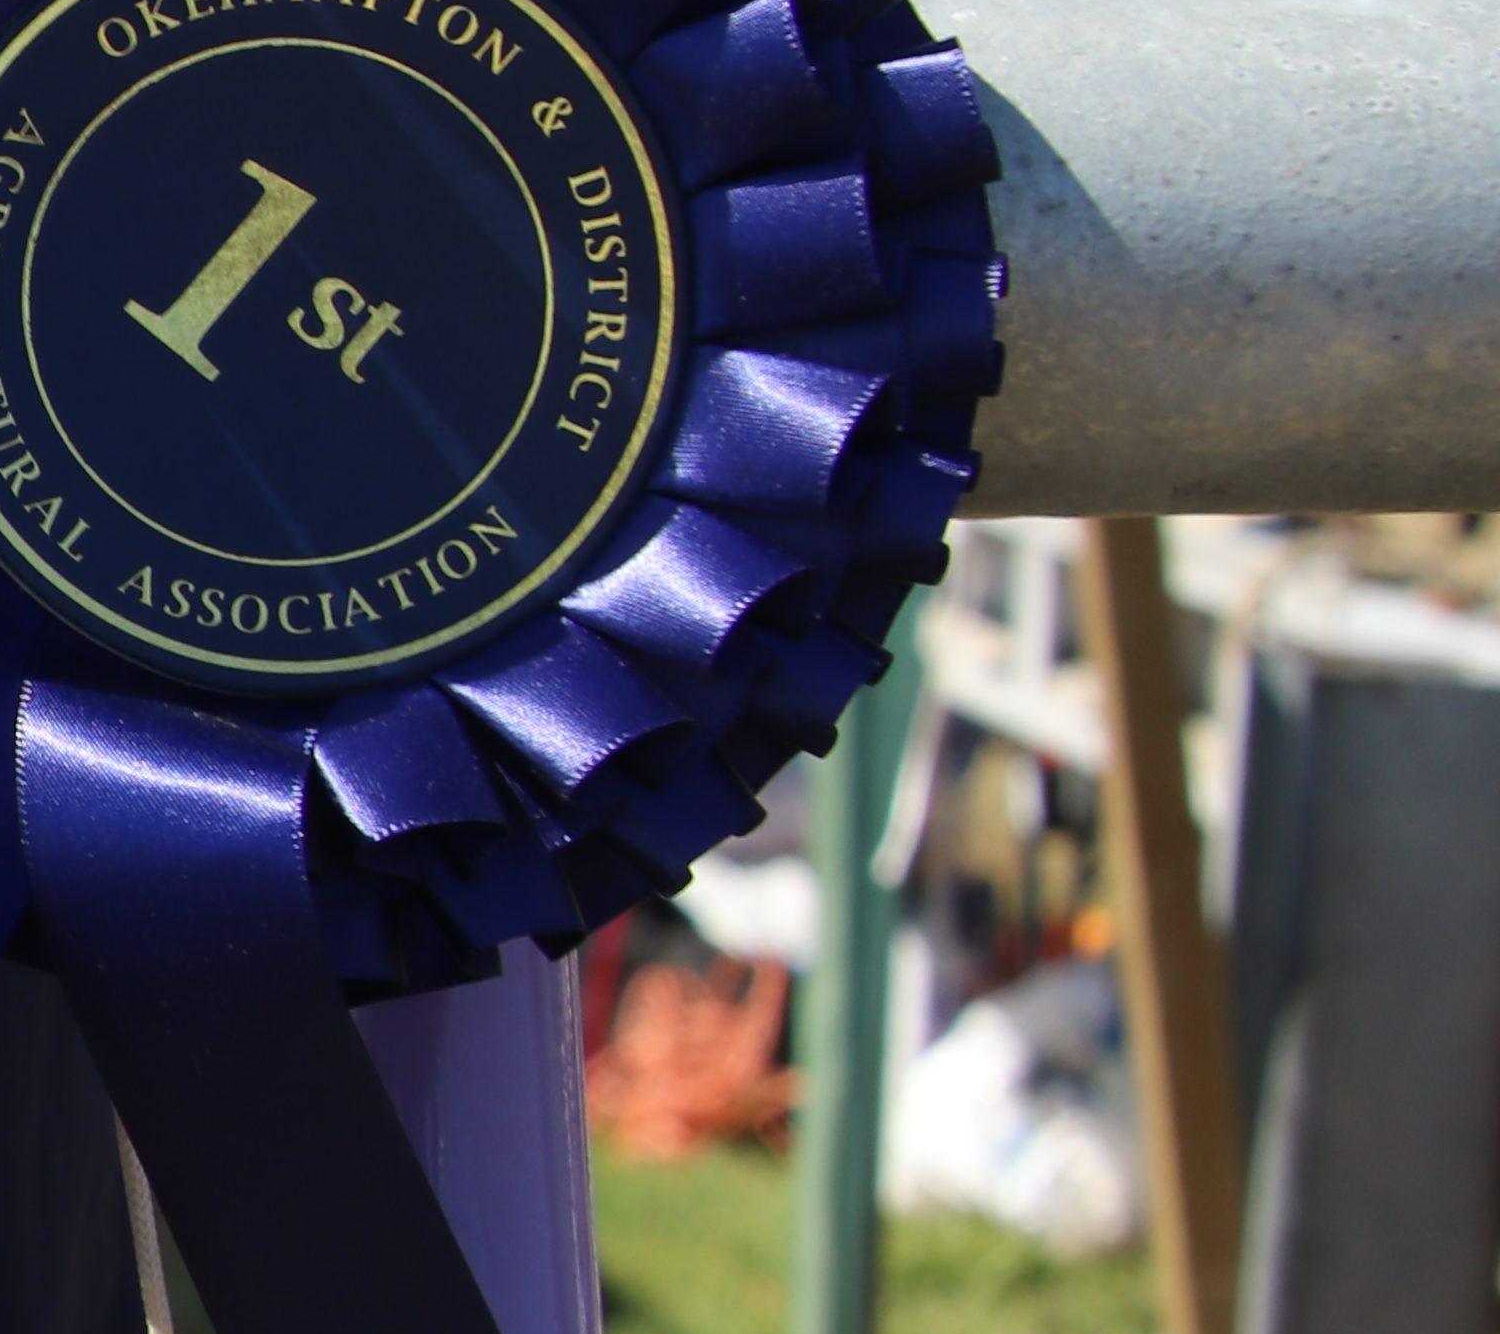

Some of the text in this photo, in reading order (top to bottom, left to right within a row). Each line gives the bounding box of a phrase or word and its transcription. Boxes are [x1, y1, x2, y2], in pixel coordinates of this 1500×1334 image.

[123, 159, 404, 384] 1st
[532, 97, 573, 137] &
[557, 165, 627, 452] DISTRICT
[118, 504, 518, 634] ASSOCIATION
